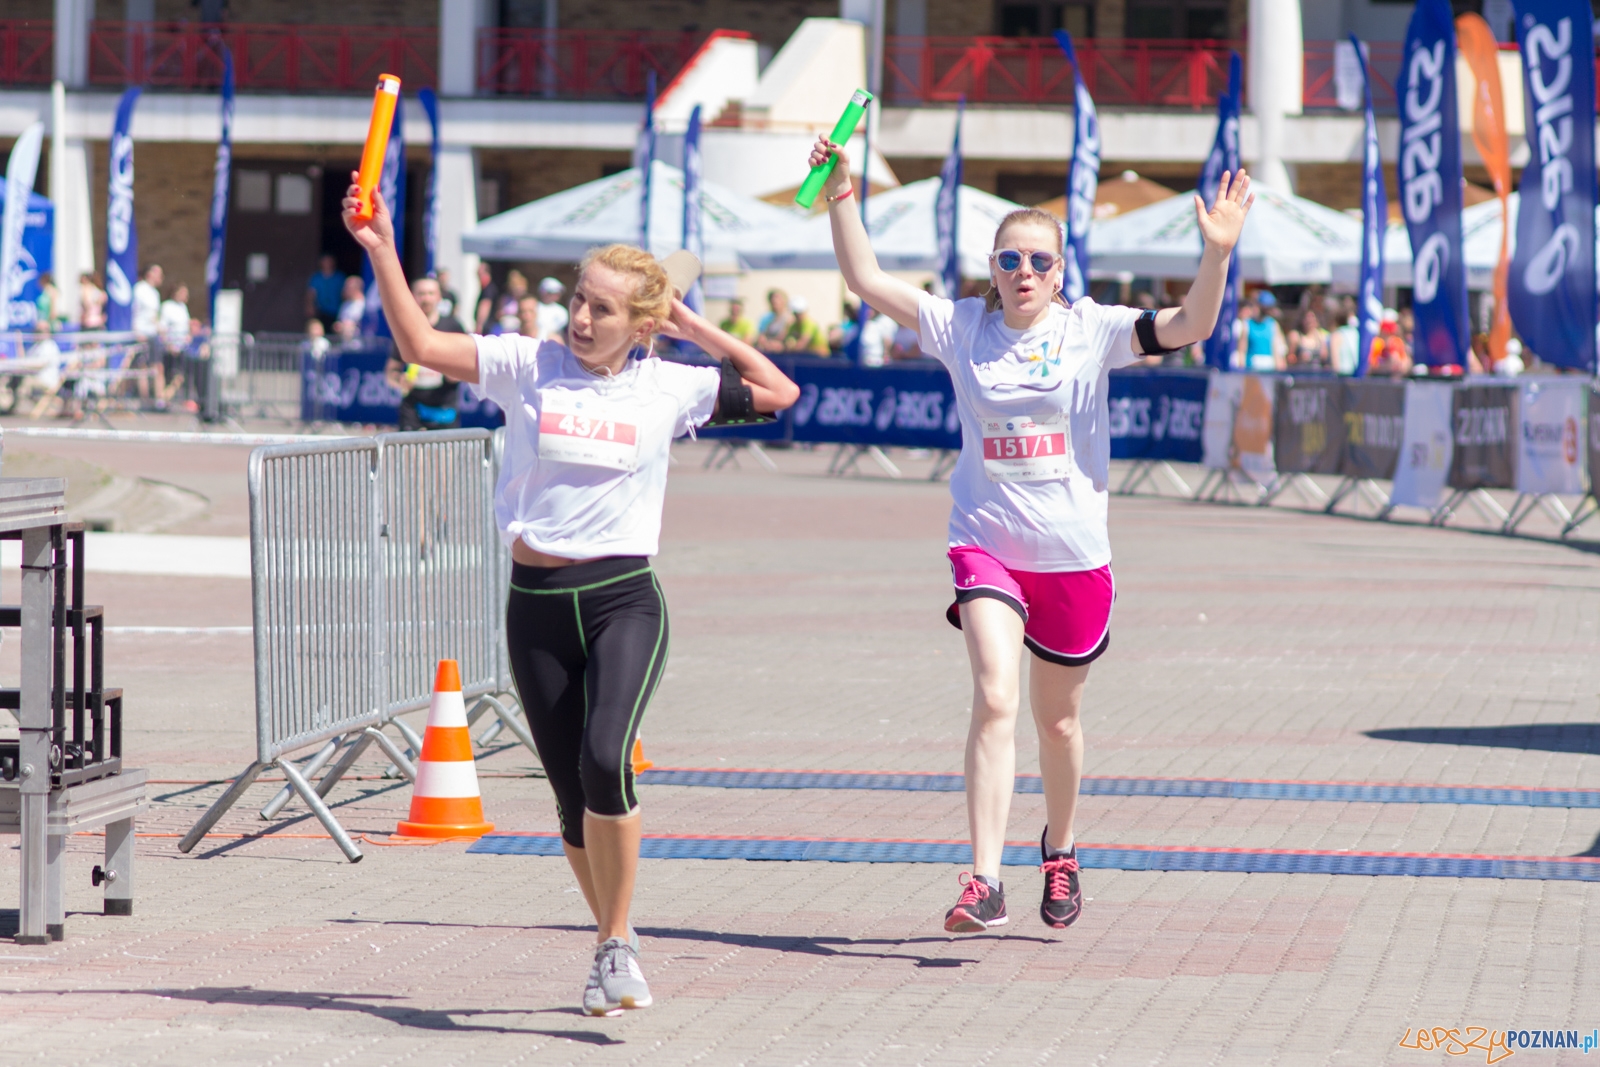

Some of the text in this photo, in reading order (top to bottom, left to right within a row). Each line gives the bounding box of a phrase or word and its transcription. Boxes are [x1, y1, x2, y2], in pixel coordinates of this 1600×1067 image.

[816, 387, 874, 427] asics
[894, 390, 945, 431] asics
[558, 413, 616, 441] 43/1
[993, 434, 1054, 458] 151/1
